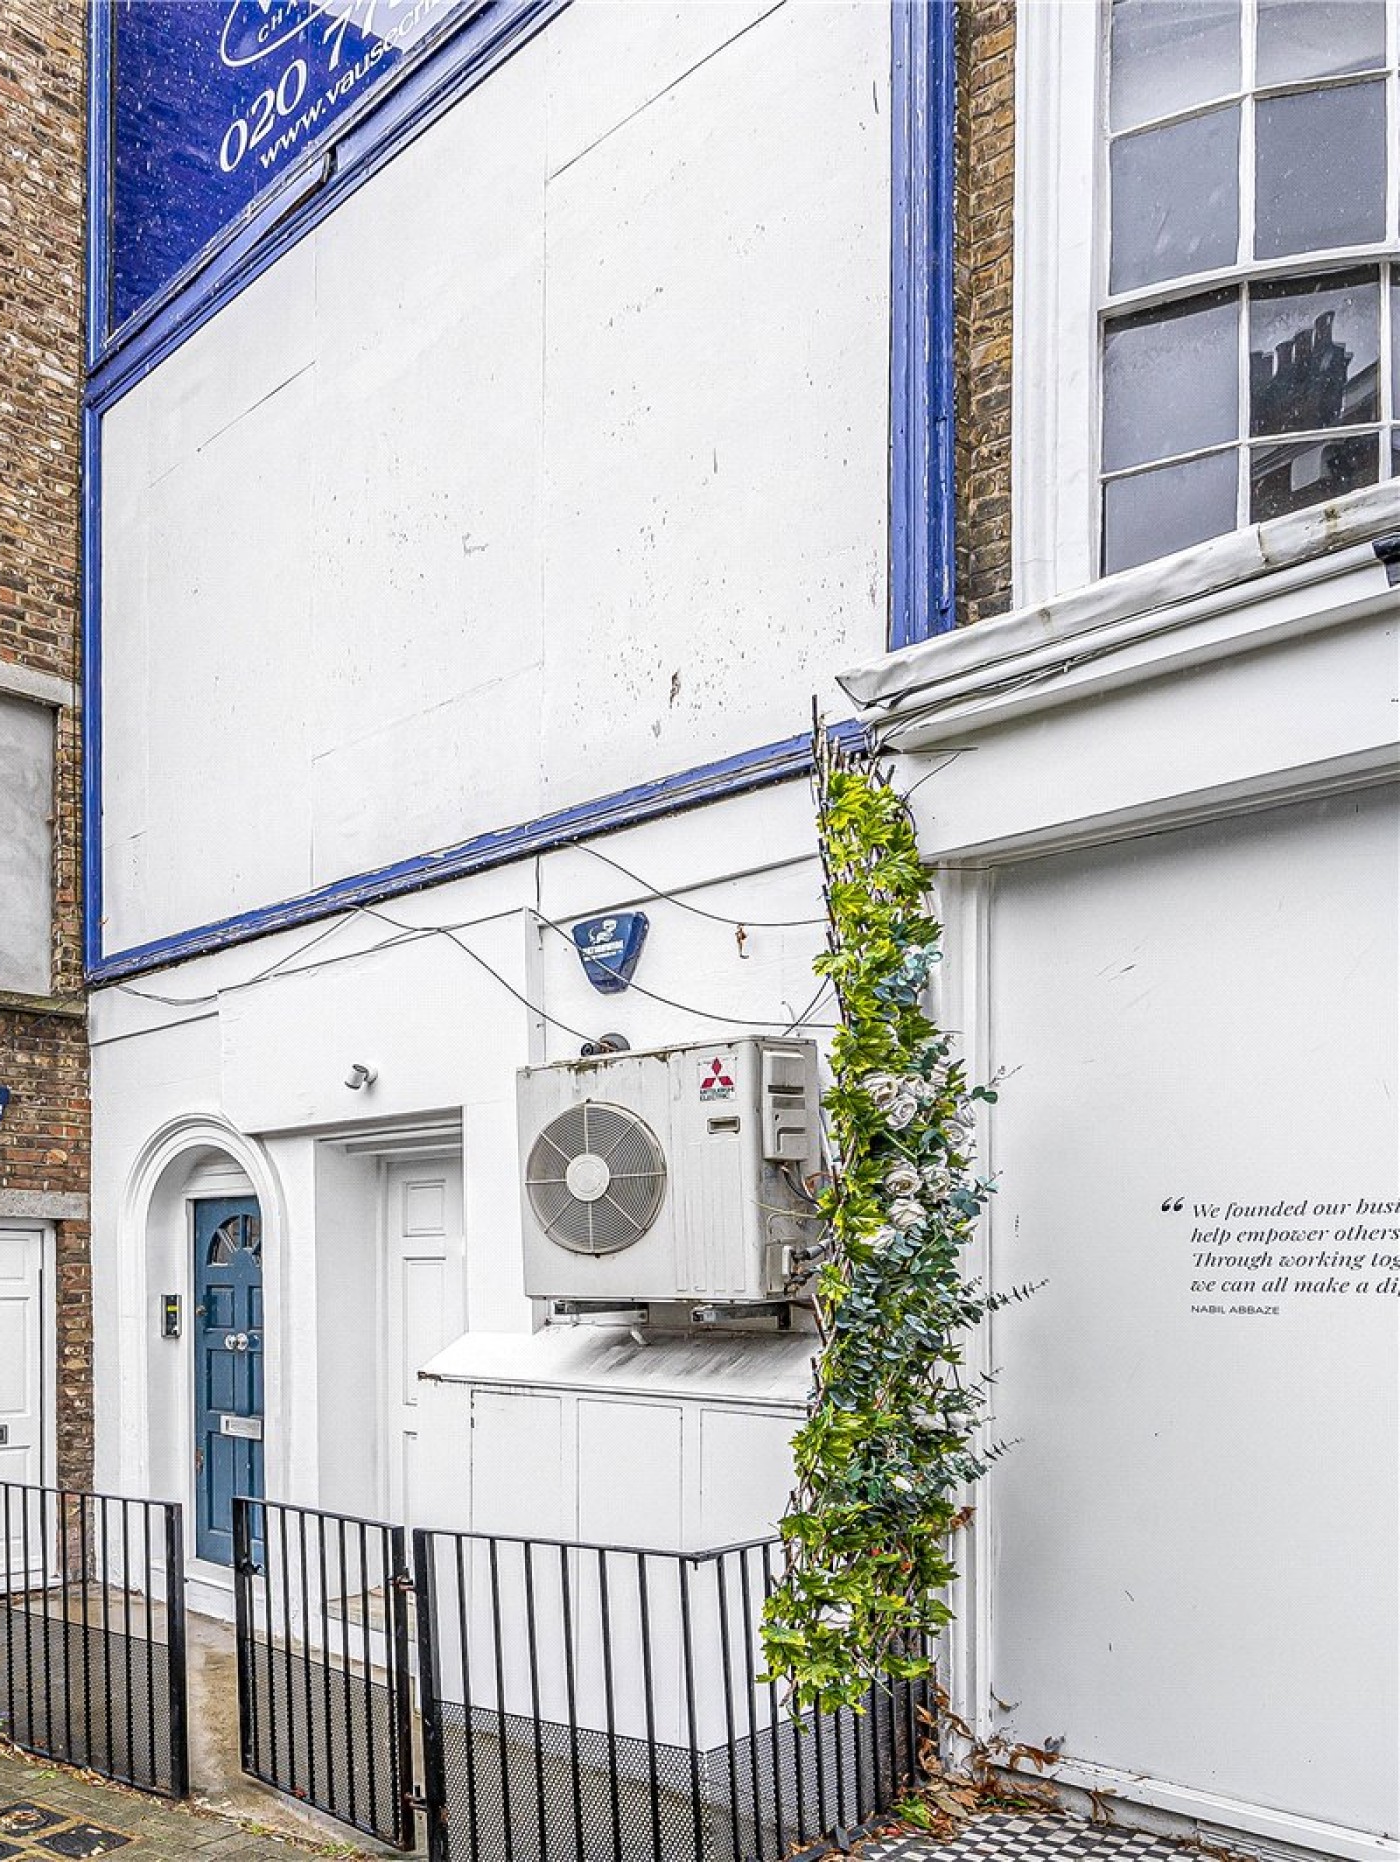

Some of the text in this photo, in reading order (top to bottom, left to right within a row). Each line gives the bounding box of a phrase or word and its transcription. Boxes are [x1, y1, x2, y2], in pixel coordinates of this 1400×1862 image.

[220, 59, 307, 172] 020
[1193, 1203, 1221, 1218] We
[1224, 1200, 1308, 1221] founded
[1313, 1203, 1351, 1216] our
[1190, 1225, 1400, 1246] help empower others
[1192, 1251, 1273, 1270] Through
[1279, 1251, 1366, 1270] working
[1190, 1276, 1400, 1297] we can all make a di
[1191, 1305, 1280, 1315] NABIL ABBAZE
